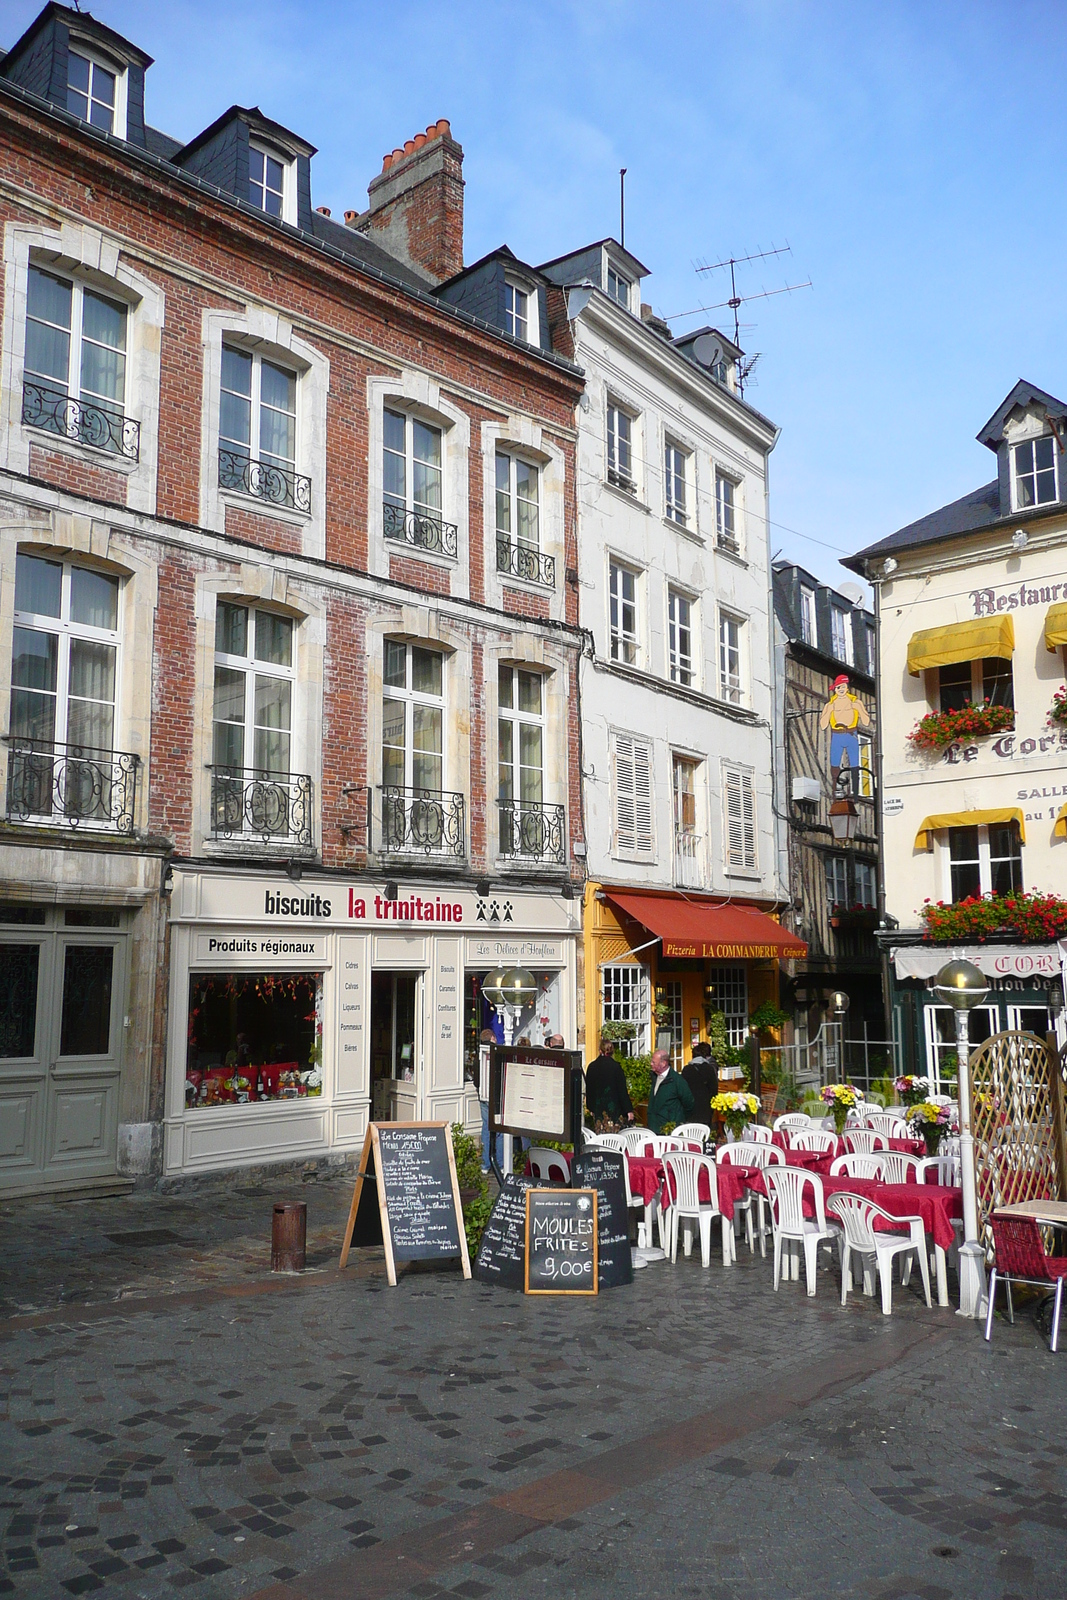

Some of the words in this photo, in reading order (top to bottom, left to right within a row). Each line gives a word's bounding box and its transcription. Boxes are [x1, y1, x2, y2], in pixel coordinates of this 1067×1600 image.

[943, 743, 979, 765] Le
[1024, 812, 1043, 822] au
[264, 890, 332, 918] biscuits
[348, 887, 366, 919] la
[374, 894, 463, 923] trinitaine
[208, 938, 258, 953] Produits
[260, 939, 315, 956] régionaux
[476, 942, 490, 955] Les
[494, 942, 519, 955] Délices
[520, 942, 555, 958] d'Honfleur
[666, 944, 696, 956] Pizzeria
[702, 944, 715, 958] LA
[716, 944, 779, 958] COMMANDERIE
[345, 961, 359, 969] Cidres
[994, 954, 1062, 974] COR
[342, 1003, 360, 1012] Liqueurs
[525, 1056, 532, 1064] Le
[533, 1216, 594, 1235] MOULES
[534, 1237, 589, 1251] FRITES
[540, 1257, 593, 1280] 9,00€
